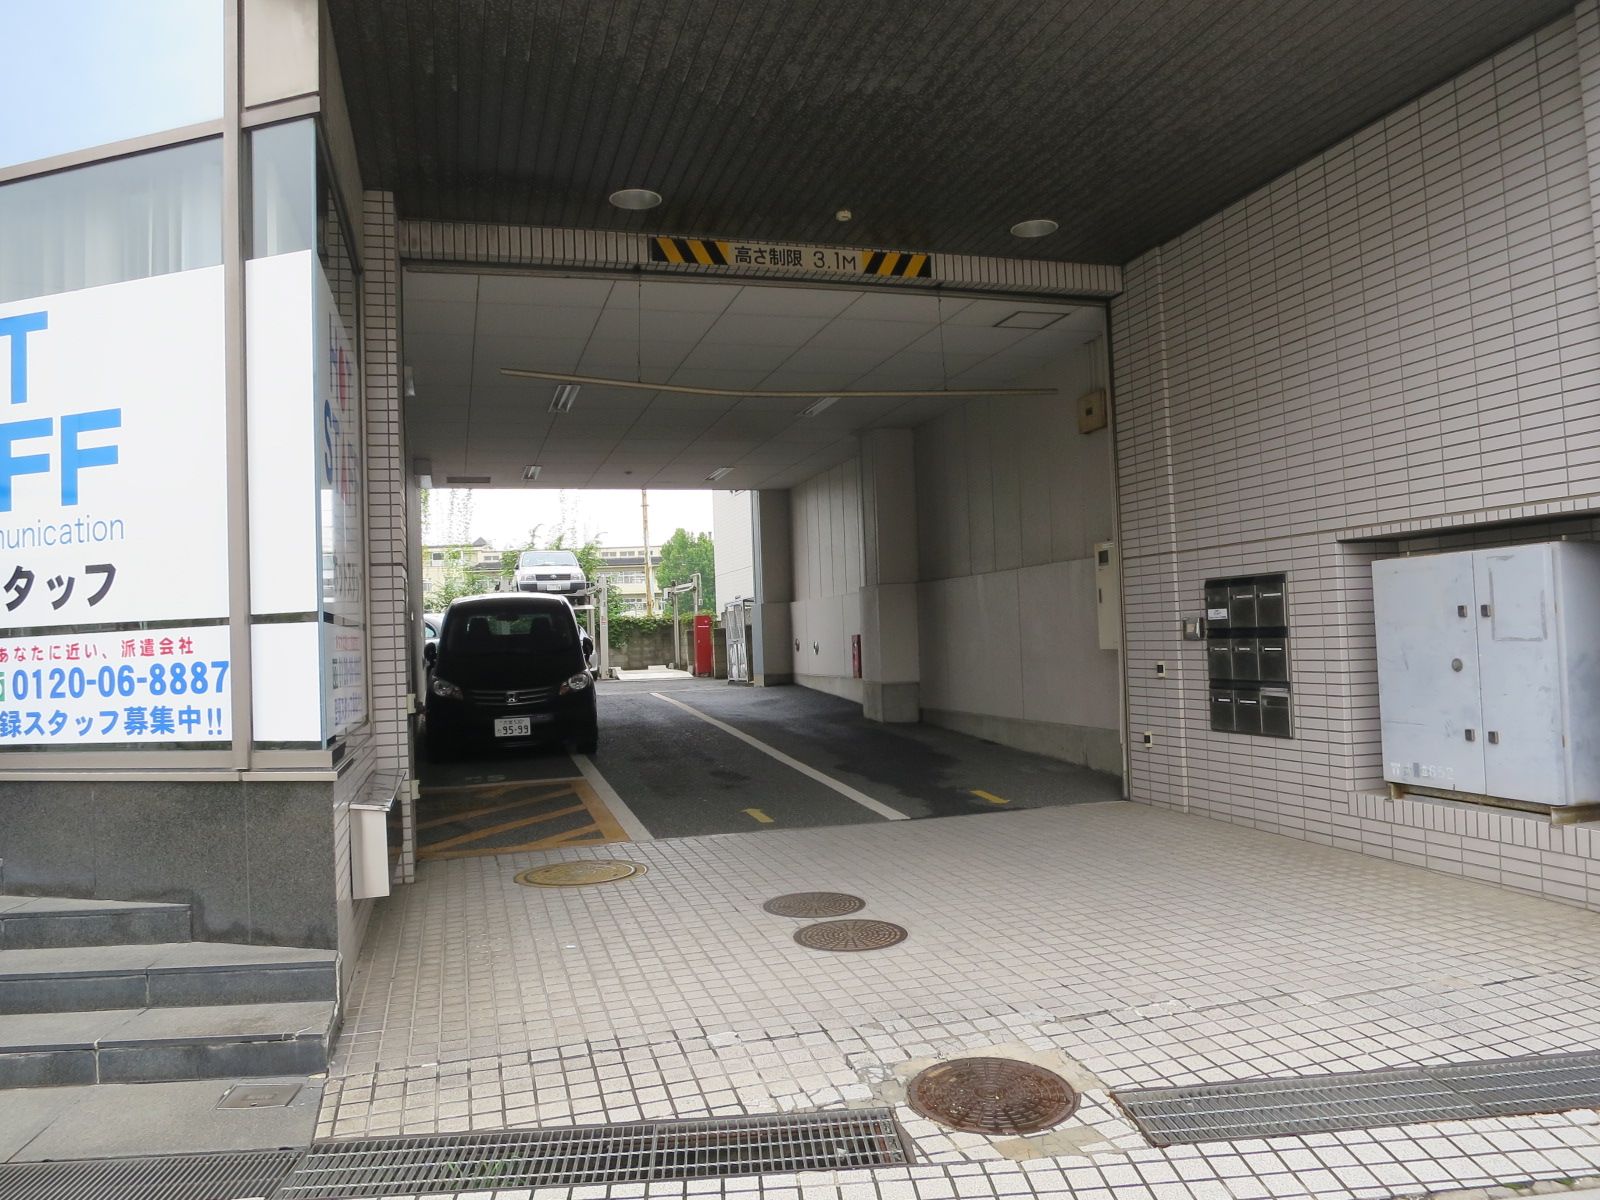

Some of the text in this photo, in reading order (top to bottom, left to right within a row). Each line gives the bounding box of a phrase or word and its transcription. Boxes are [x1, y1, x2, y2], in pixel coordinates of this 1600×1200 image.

[733, 245, 857, 271] 高さ制限 3.1M
[3, 563, 117, 612] タッフ
[12, 660, 230, 701] 0120-06-8887
